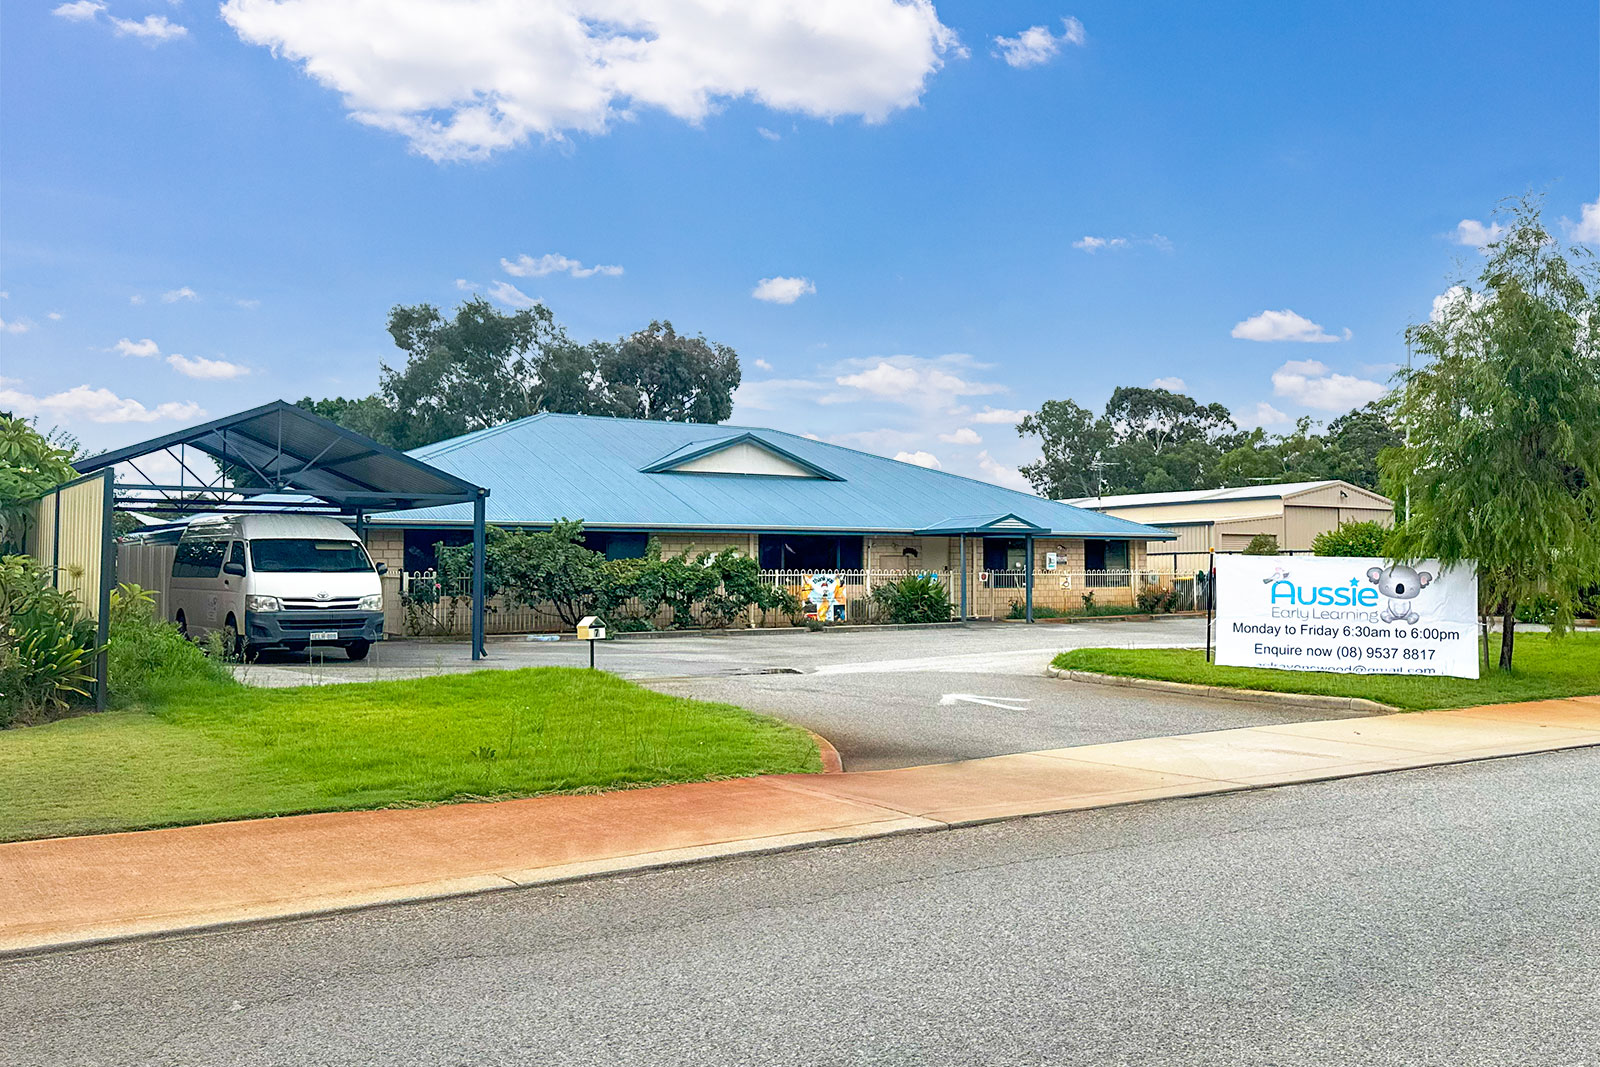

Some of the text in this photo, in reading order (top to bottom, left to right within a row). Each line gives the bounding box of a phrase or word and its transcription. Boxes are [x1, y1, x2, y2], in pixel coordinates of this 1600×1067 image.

[1271, 577, 1379, 607] Aussie
[1271, 606, 1380, 624] Early Learning
[1232, 622, 1460, 642] Monday to Friday 6:30am to 6:00pm
[1254, 643, 1436, 660] Enquire now (08) 9537 8817
